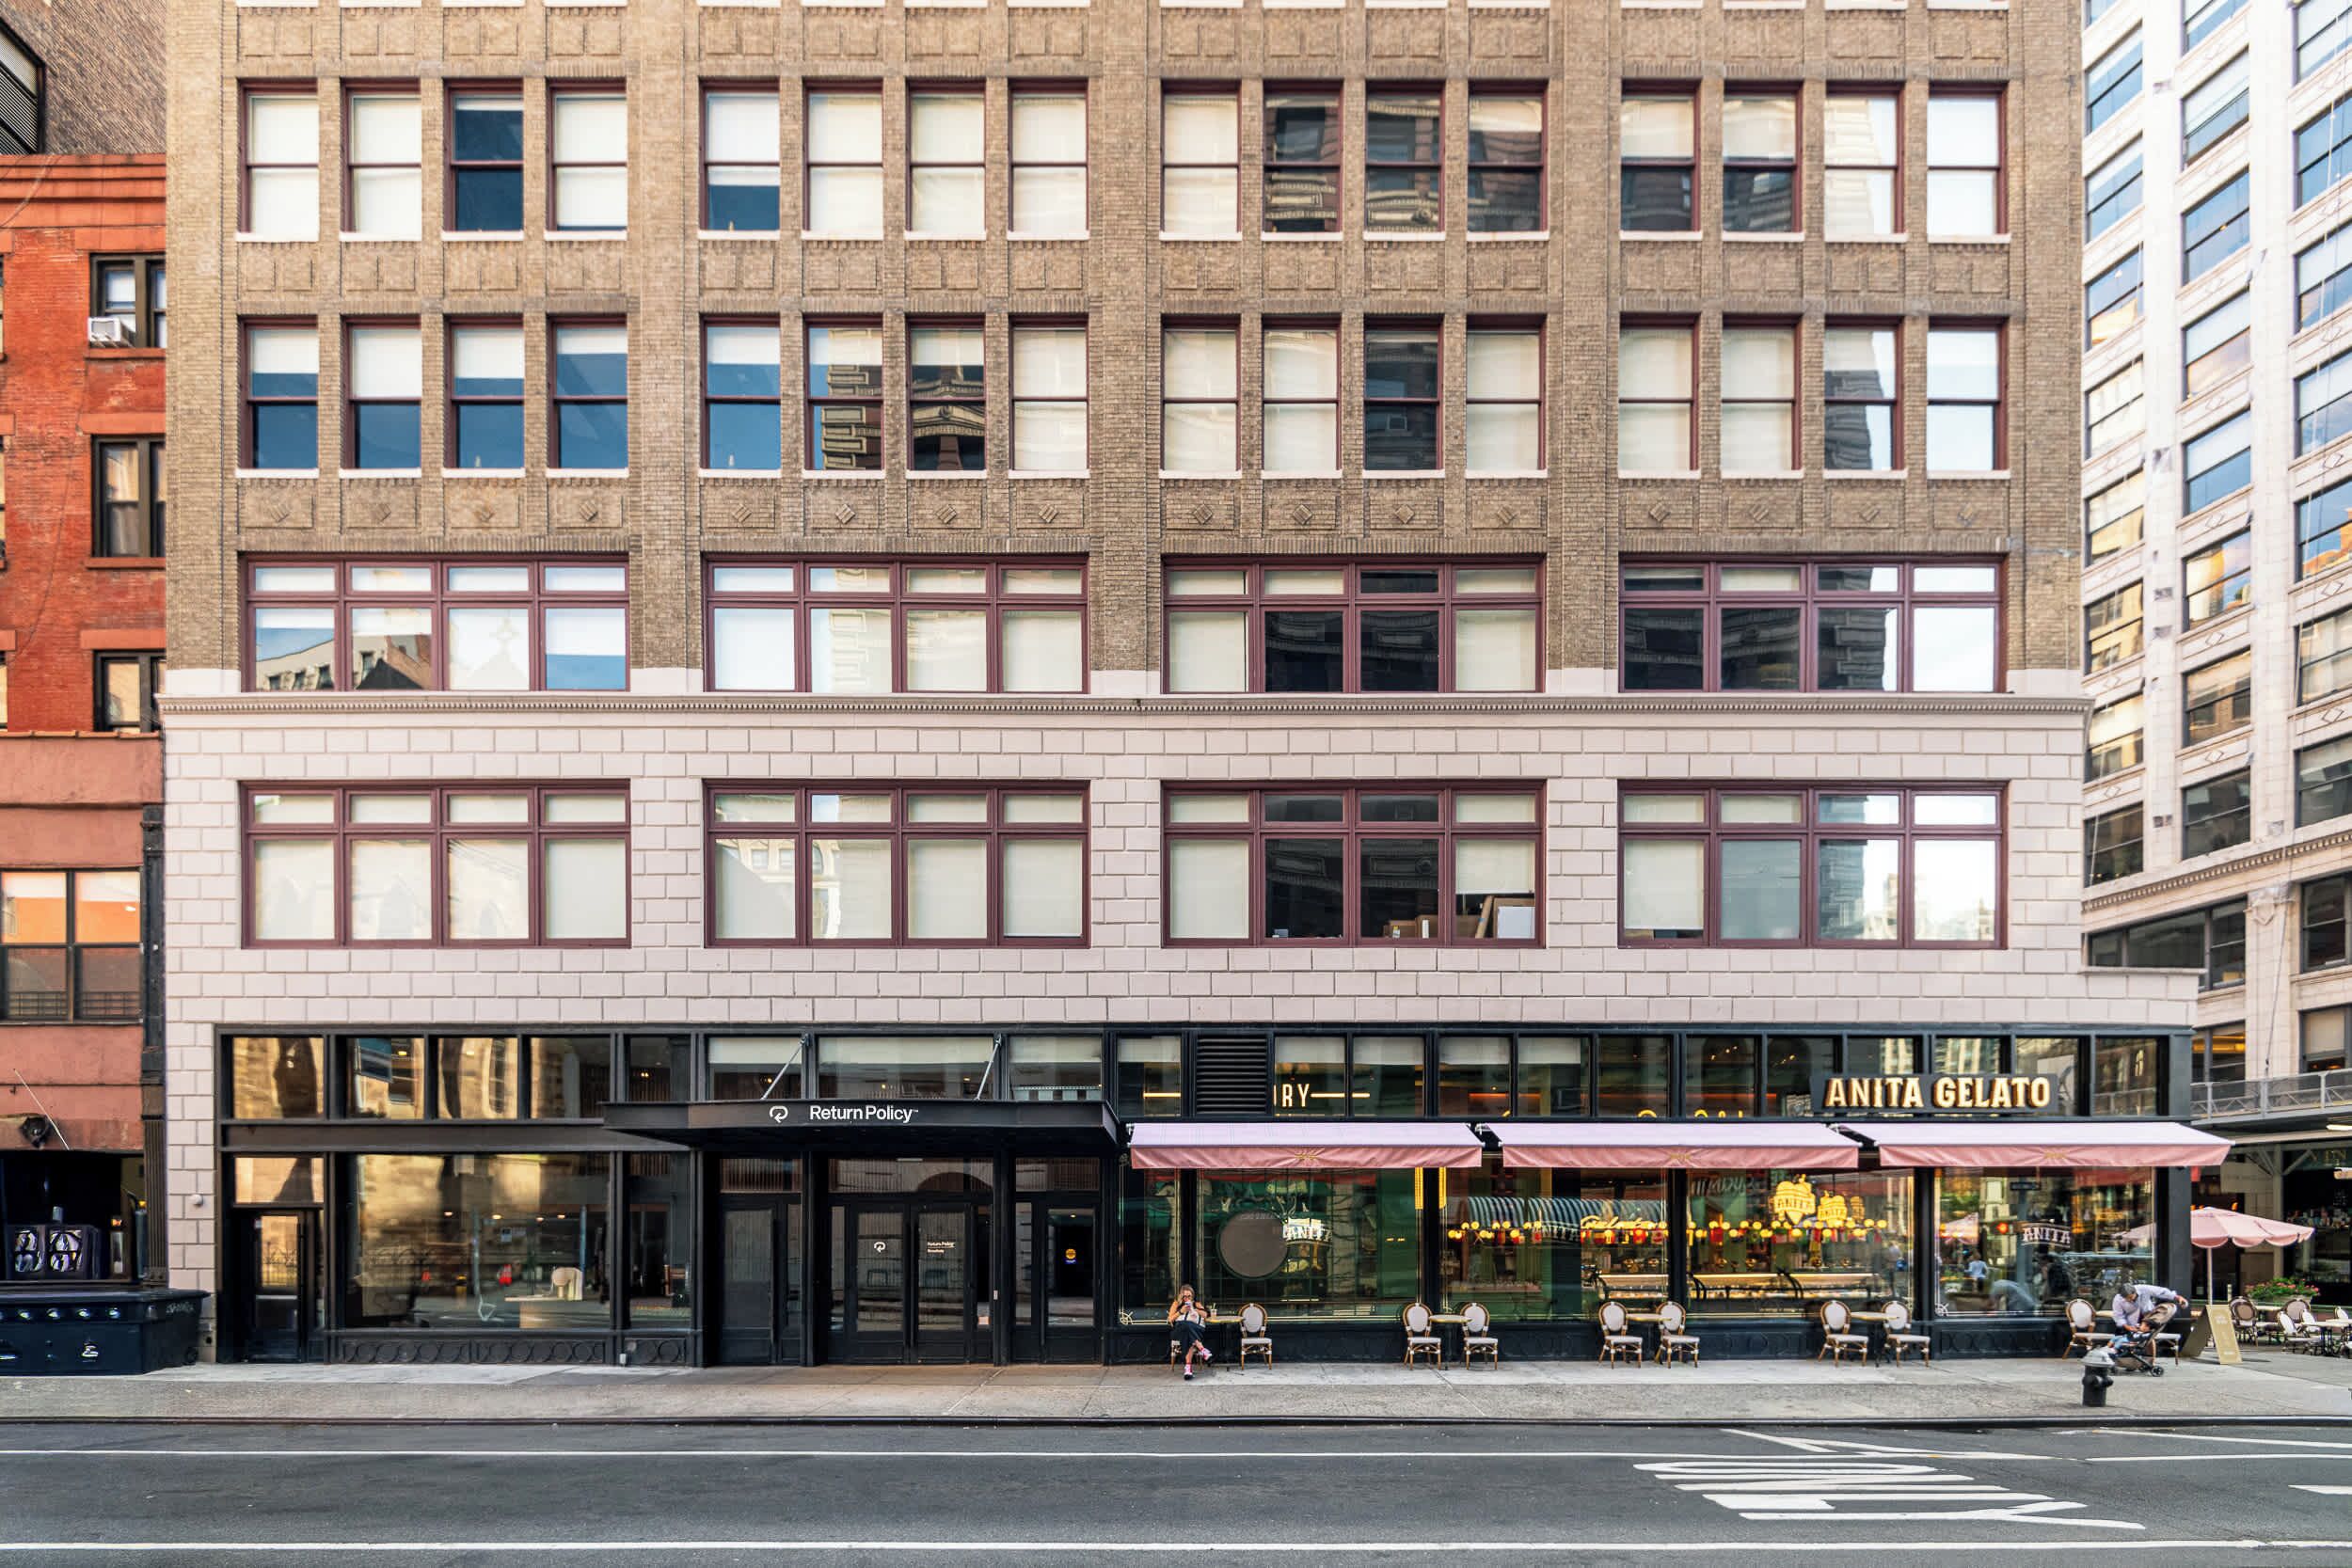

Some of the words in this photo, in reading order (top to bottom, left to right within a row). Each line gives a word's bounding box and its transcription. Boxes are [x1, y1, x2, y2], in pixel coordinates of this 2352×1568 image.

[1273, 1084, 1310, 1107] RY
[1824, 1077, 1924, 1108] ANITA
[1933, 1076, 2051, 1108] GELATO
[810, 1105, 863, 1120] Return
[2022, 1227, 2071, 1243] ANITA
